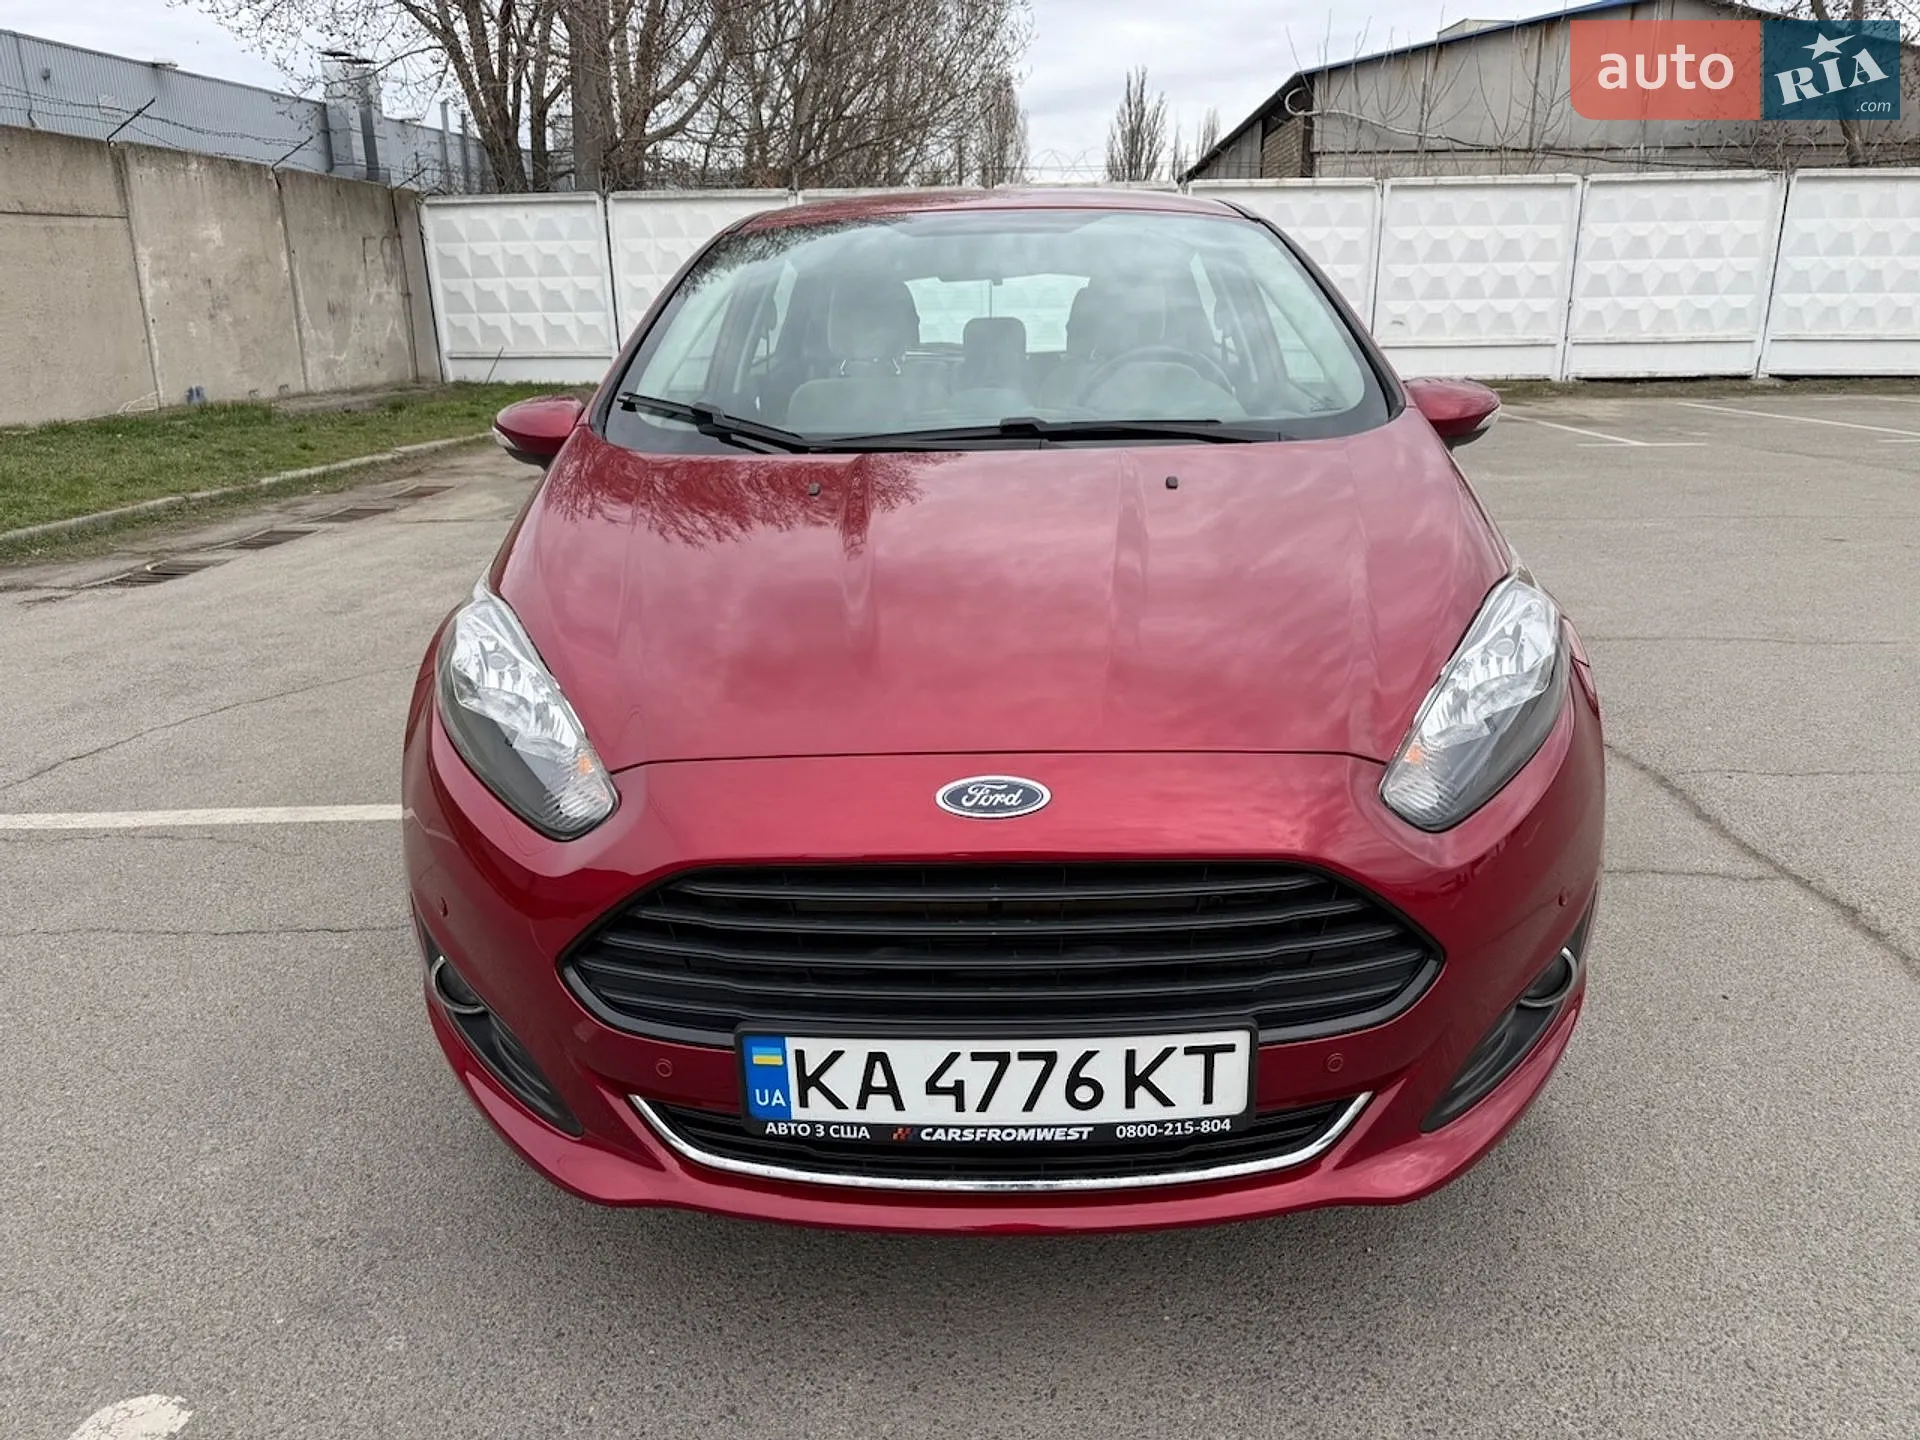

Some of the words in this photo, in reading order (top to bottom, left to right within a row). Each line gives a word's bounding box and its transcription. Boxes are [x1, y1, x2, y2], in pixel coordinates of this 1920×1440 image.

[961, 783, 1024, 807] Ford
[794, 1048, 906, 1112] KA
[925, 1049, 1105, 1113] 4776
[1124, 1043, 1237, 1110] KT
[754, 1088, 787, 1107] UA
[764, 1121, 812, 1138] АВТО
[829, 1125, 871, 1140] США
[920, 1126, 1095, 1142] CARSFROMWEST
[1115, 1118, 1232, 1140] 0800-215-804
